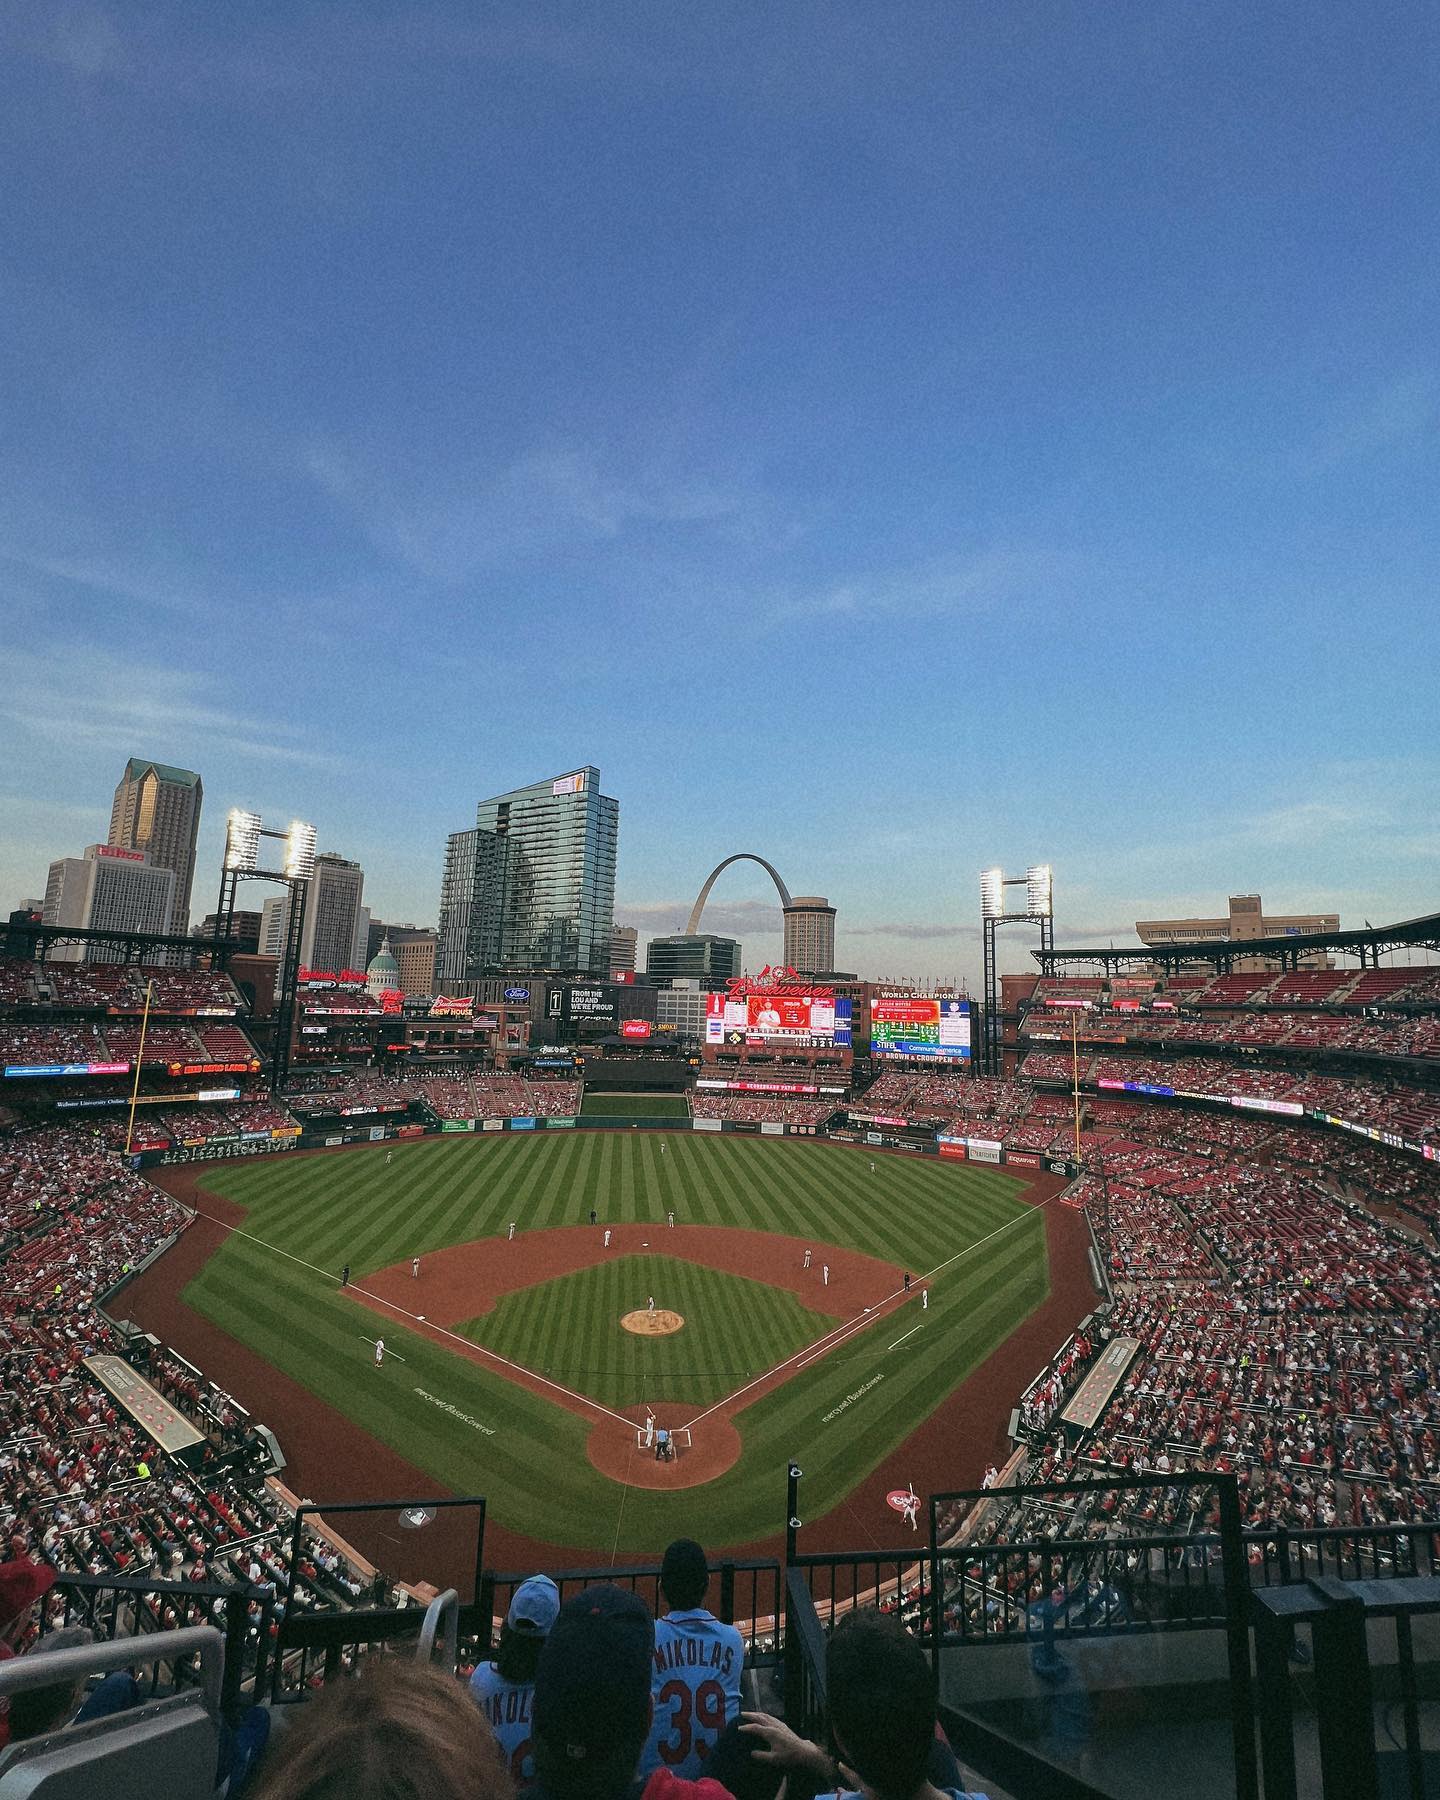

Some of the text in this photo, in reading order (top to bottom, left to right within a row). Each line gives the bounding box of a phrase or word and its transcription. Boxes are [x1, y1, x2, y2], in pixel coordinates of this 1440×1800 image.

[726, 976, 834, 996] Budweiser
[510, 988, 525, 999] Ford
[433, 998, 473, 1008] Budweiser
[430, 1007, 473, 1016] BREW HOUSE
[625, 1025, 648, 1033] Coca-Cola
[876, 1041, 897, 1049] STIFEL
[885, 1052, 909, 1060] BROWN
[916, 1054, 953, 1063] CROUPPEN
[1008, 1155, 1037, 1164] EQUIFAX
[653, 1639, 734, 1675] MIKOLAS
[657, 1680, 726, 1765] 39
